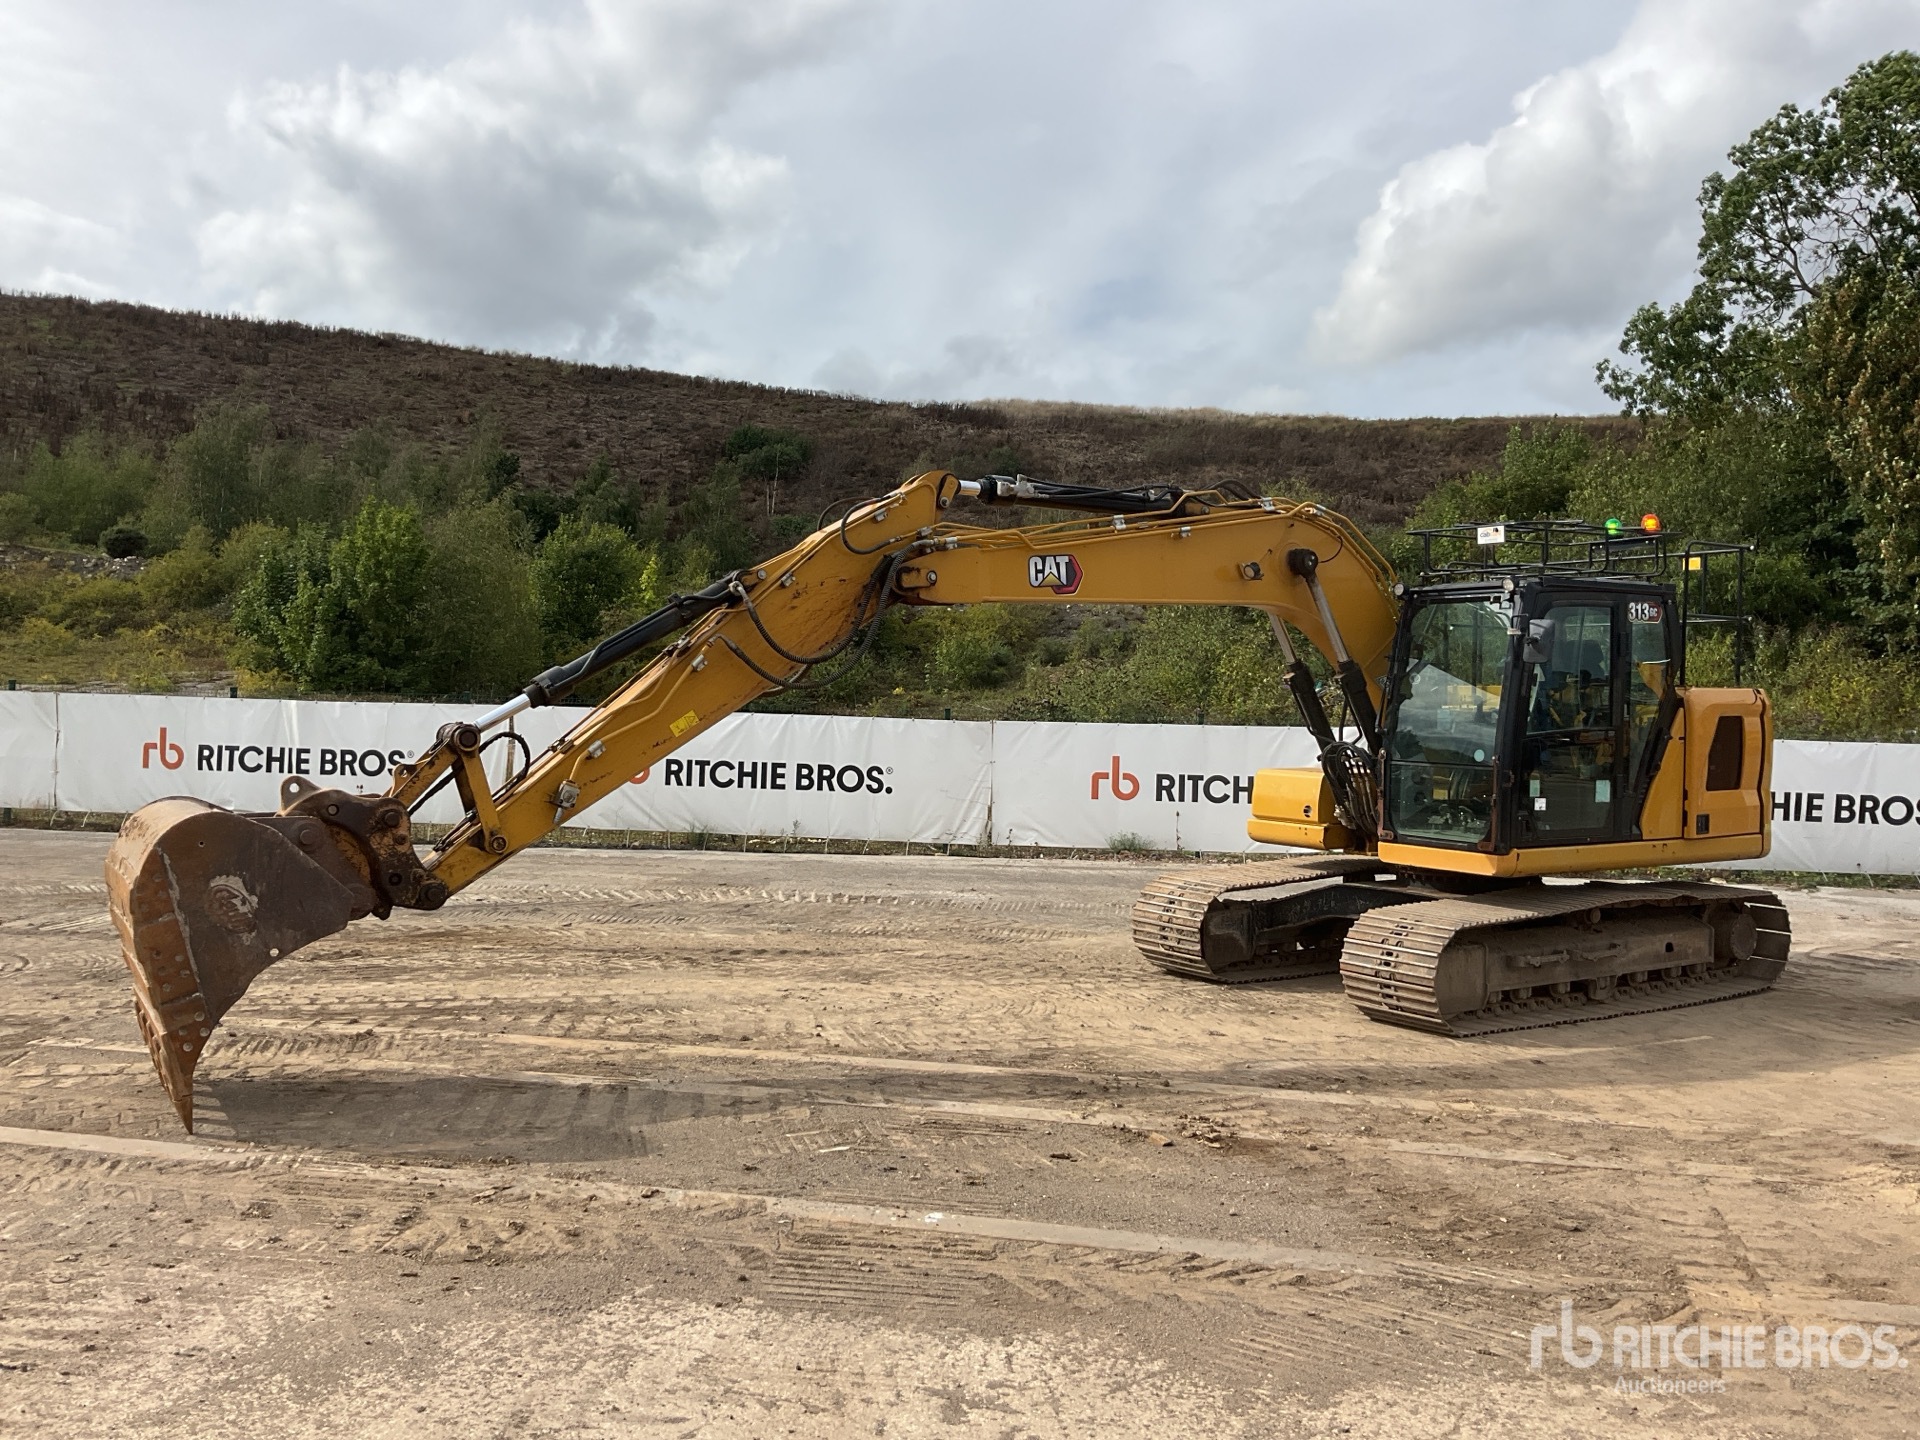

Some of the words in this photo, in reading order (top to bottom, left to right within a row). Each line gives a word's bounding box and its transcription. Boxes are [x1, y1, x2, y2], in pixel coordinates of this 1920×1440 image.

[1028, 555, 1070, 587] CAT
[1628, 602, 1650, 621] 313
[197, 744, 311, 775] RITCHIE
[664, 758, 786, 790] RITCHIE
[1155, 773, 1254, 805] RITCH
[1771, 791, 1825, 823] HIE
